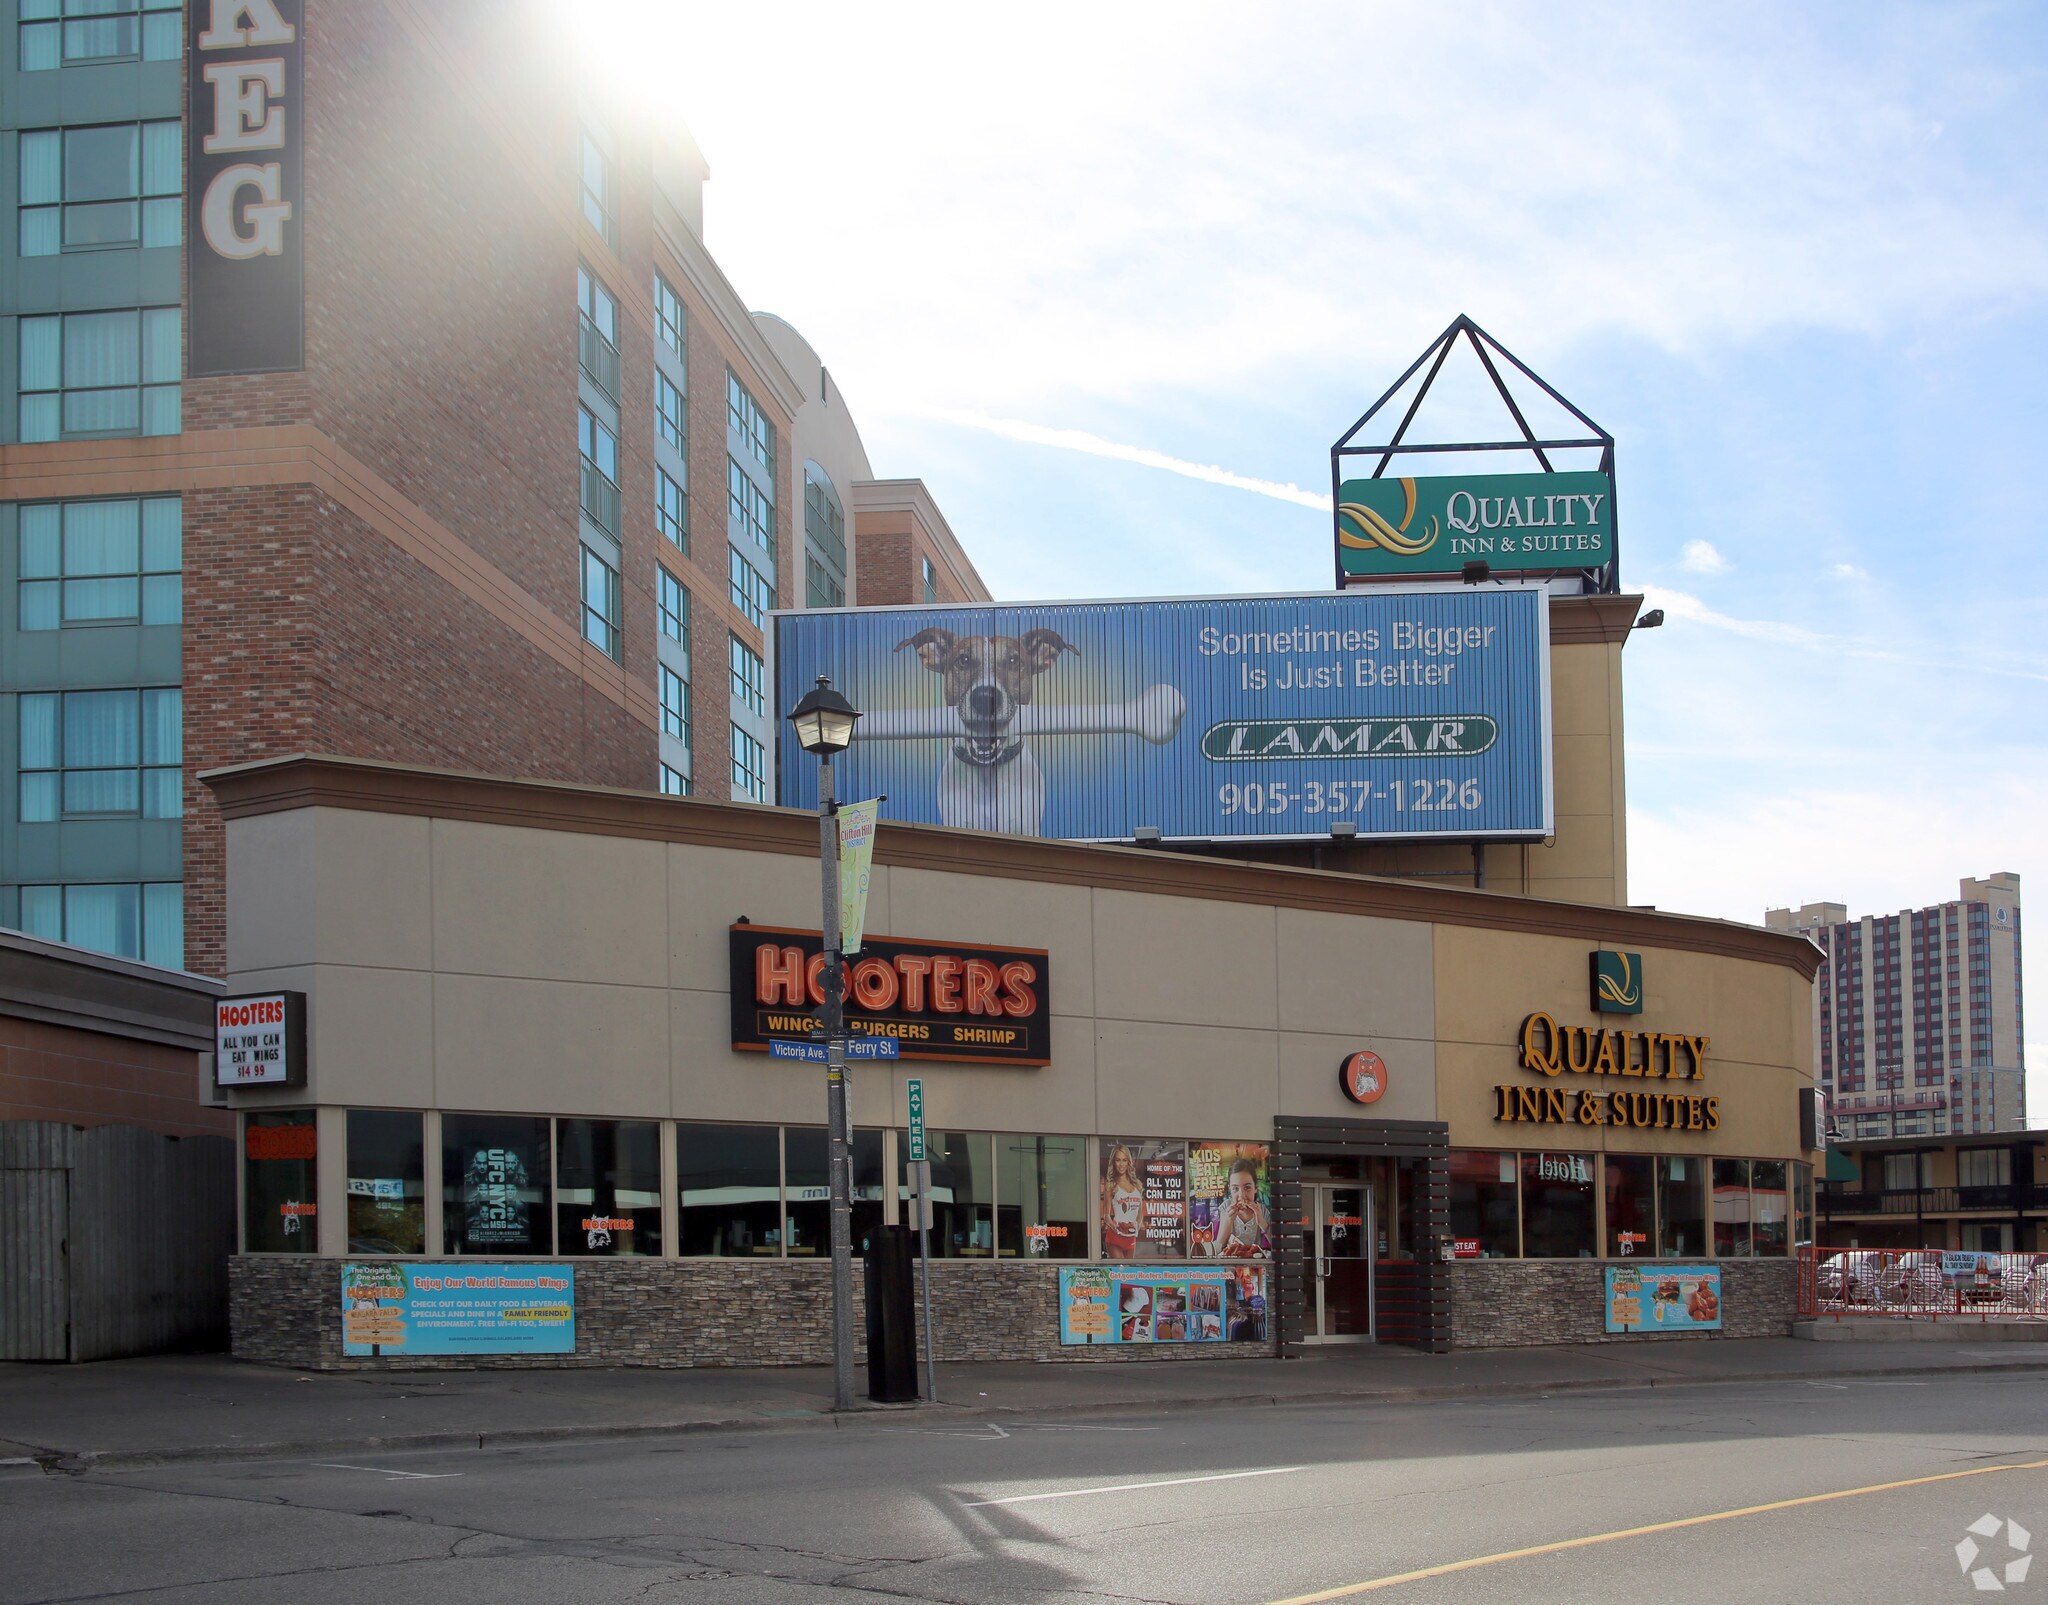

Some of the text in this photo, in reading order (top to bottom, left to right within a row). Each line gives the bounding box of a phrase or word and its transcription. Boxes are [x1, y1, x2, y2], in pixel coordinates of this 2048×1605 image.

[1446, 490, 1604, 534] QUALITY
[1450, 534, 1602, 554] INN & SUITES
[1199, 621, 1496, 657] Sometimes Bigger
[1241, 659, 1455, 691] Is Just Better
[1226, 721, 1466, 755] LAMAR
[1218, 777, 1482, 816] 905-357-1226
[841, 829, 861, 842] Clifton
[755, 942, 1038, 1018] HOOTERS
[219, 1001, 284, 1027] HOOTERS
[851, 1021, 930, 1039] BURGERS
[953, 1028, 1016, 1044] SHRIMP
[223, 1033, 280, 1049] ALL YOU CAN
[848, 1040, 895, 1056] Ferry St.
[1520, 1011, 1711, 1080] QUALITY
[232, 1049, 279, 1063] EAT WINGS
[775, 1044, 826, 1059] Victoria Ave.
[254, 1064, 265, 1077] 99
[909, 1084, 921, 1112] PAY
[1497, 1084, 1721, 1131] INN & SUITES
[911, 1116, 922, 1154] HERE
[1192, 1149, 1221, 1163] KIDS
[1196, 1162, 1220, 1176] EAT
[488, 1148, 506, 1220] UFC NYC
[1146, 1178, 1181, 1188] ALL YOU
[1194, 1176, 1225, 1190] FREE
[1146, 1190, 1182, 1199] CAN EAT
[280, 1203, 317, 1215] HOOTERS
[1146, 1203, 1183, 1215] WINGS
[490, 1220, 507, 1228] MSG
[582, 1218, 634, 1230] HOOTERS
[1151, 1218, 1178, 1227] EVERY
[1025, 1226, 1068, 1237] HOOTERS
[364, 1267, 391, 1275] Original
[1109, 1271, 1122, 1280] Get
[1122, 1272, 1137, 1281] your
[1138, 1271, 1162, 1279] Hooters
[1163, 1271, 1188, 1281] Niagara
[1189, 1271, 1205, 1280] Falls
[1204, 1272, 1218, 1281] gear
[413, 1276, 568, 1291] Enjoy Our World Famous Wings
[346, 1287, 405, 1299] HOOTERS
[1068, 1287, 1110, 1297] HOOTERS
[411, 1300, 437, 1308] CHECK
[438, 1300, 454, 1308] OUT
[456, 1300, 473, 1308] OUR
[474, 1300, 497, 1308] DAILY
[411, 1310, 446, 1318] SPECIALS
[447, 1310, 465, 1318] AND
[467, 1310, 485, 1318] DINE
[486, 1310, 496, 1318] IN
[534, 1309, 569, 1317] FRIENDLY
[417, 1320, 477, 1328] ENVIRONMENT.
[478, 1320, 496, 1328] FREE
[519, 1320, 537, 1328] TOO,
[538, 1319, 566, 1327] SWEET!
